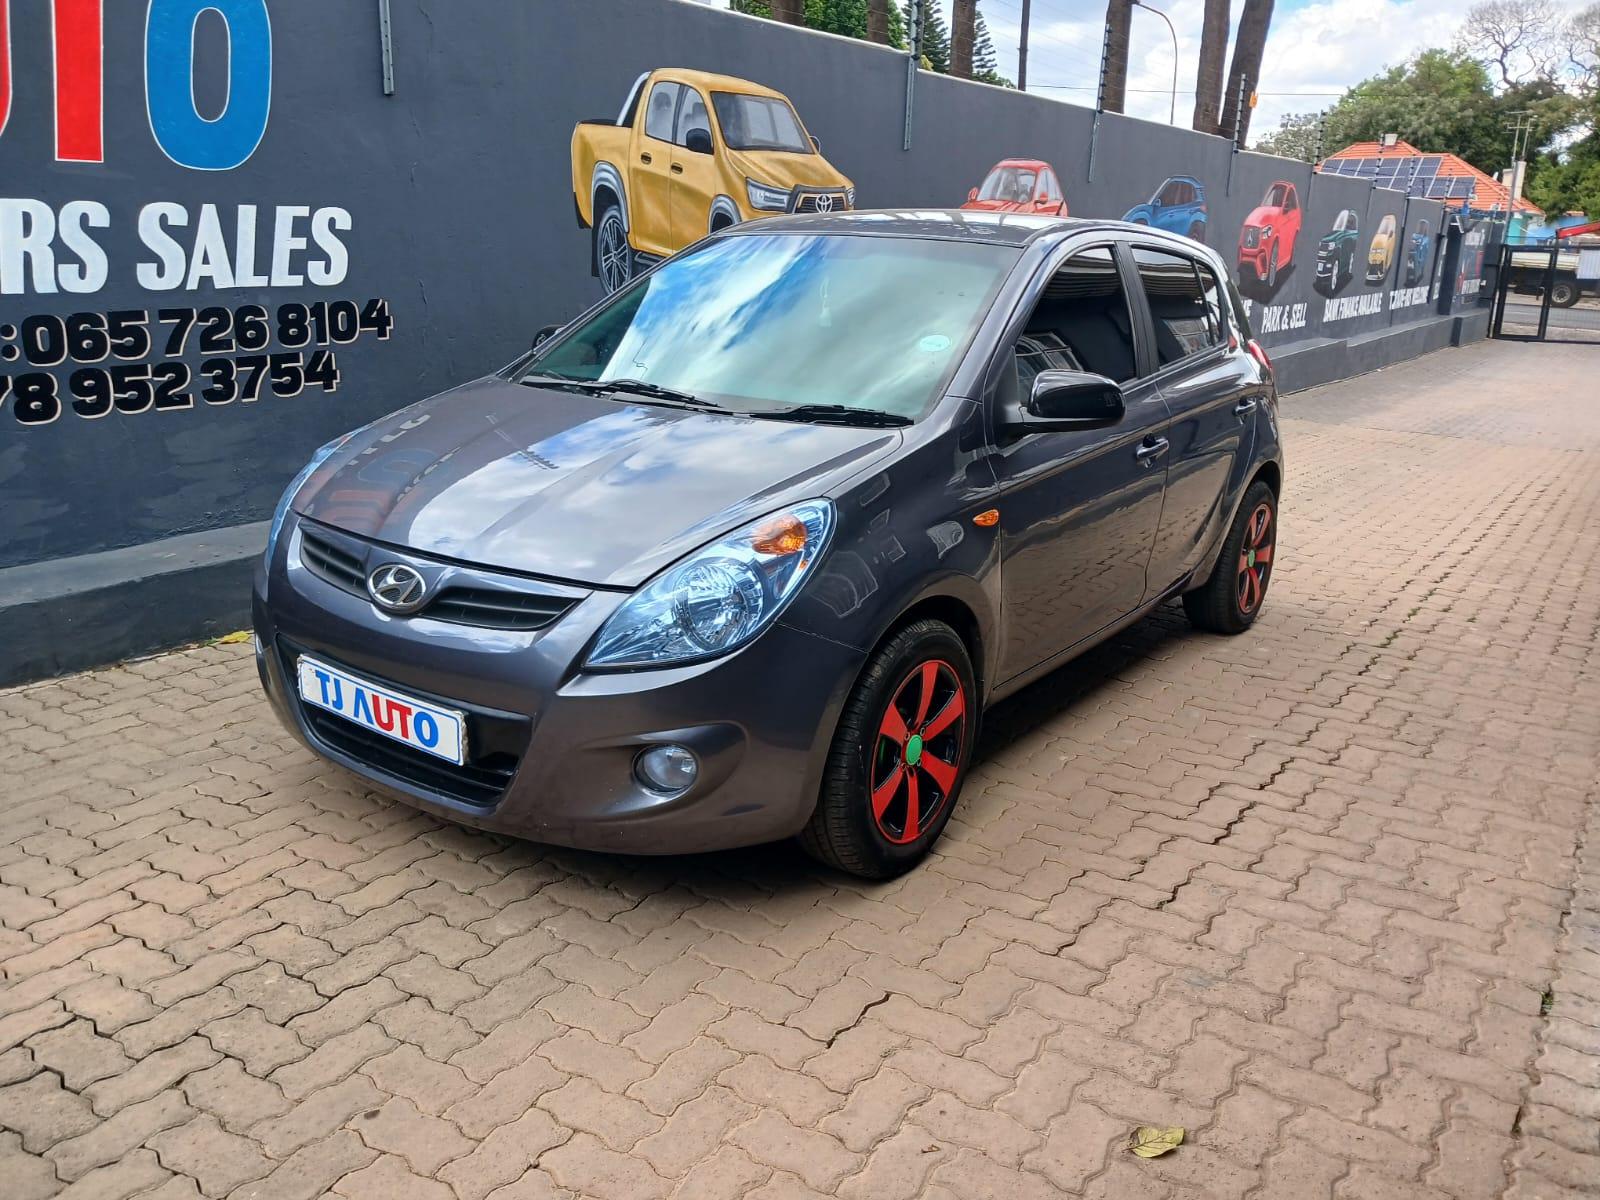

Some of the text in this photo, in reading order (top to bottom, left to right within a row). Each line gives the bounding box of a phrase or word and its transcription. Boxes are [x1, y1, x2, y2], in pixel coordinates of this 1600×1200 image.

[136, 202, 352, 291] SALES
[158, 304, 269, 357] 726
[277, 298, 394, 348] 8104
[1261, 306, 1283, 333] PARK
[1281, 305, 1290, 331] &
[1290, 302, 1308, 328] SELL
[69, 362, 194, 419] 952
[200, 350, 341, 405] 3754
[315, 669, 439, 748] TJ AUTO
